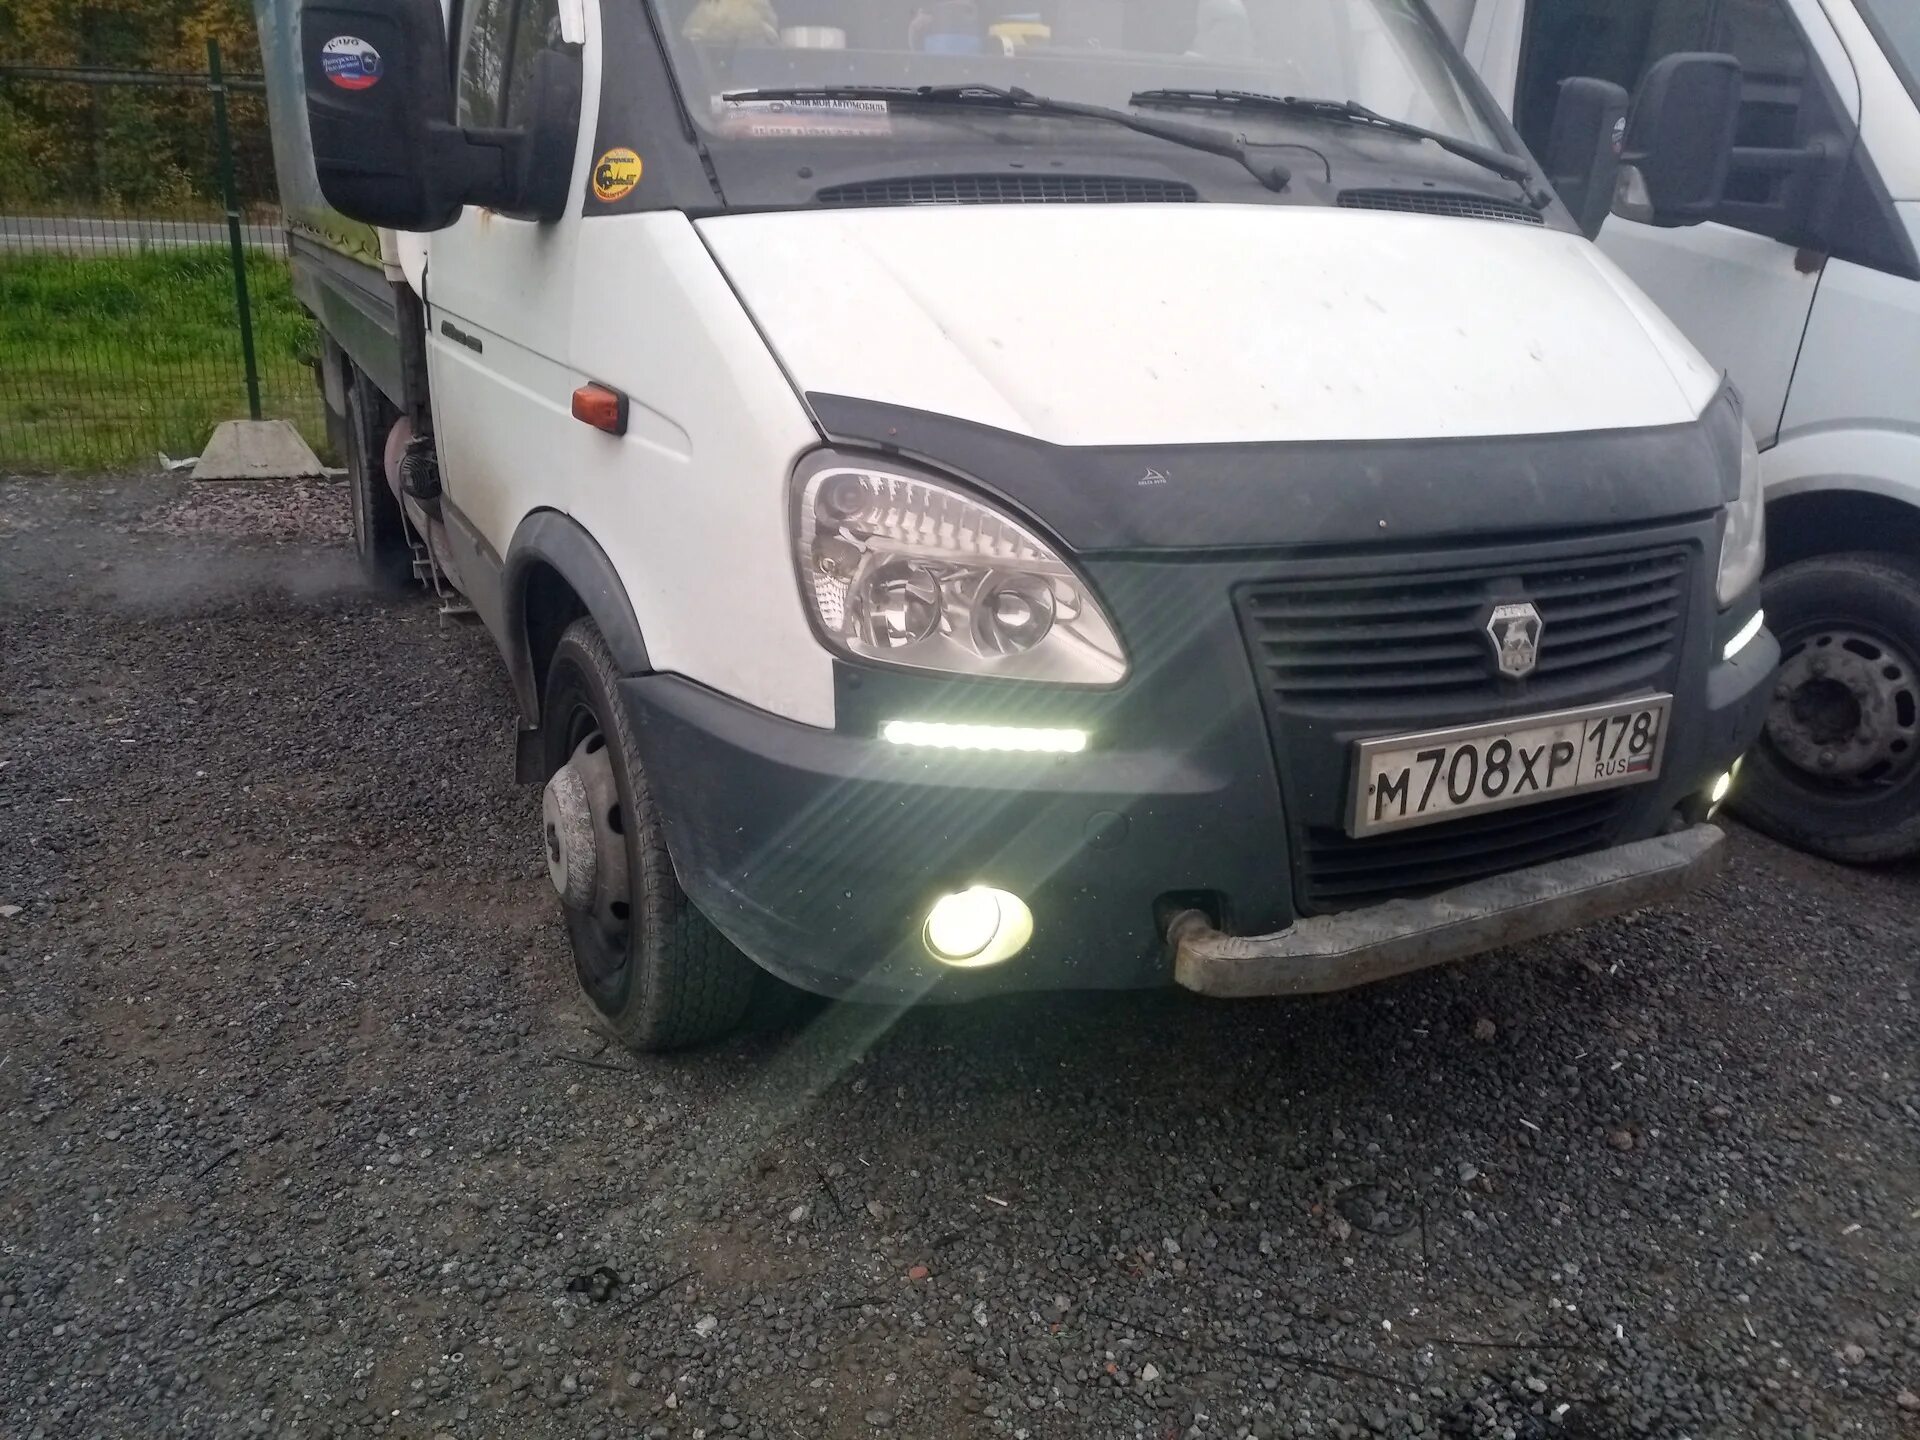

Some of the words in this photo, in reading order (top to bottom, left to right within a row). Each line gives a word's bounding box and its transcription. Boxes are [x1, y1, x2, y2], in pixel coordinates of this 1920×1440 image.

[832, 100, 885, 112] АВТОМОБИЛЬ
[1588, 711, 1652, 763] 178
[1594, 758, 1626, 779] RUS
